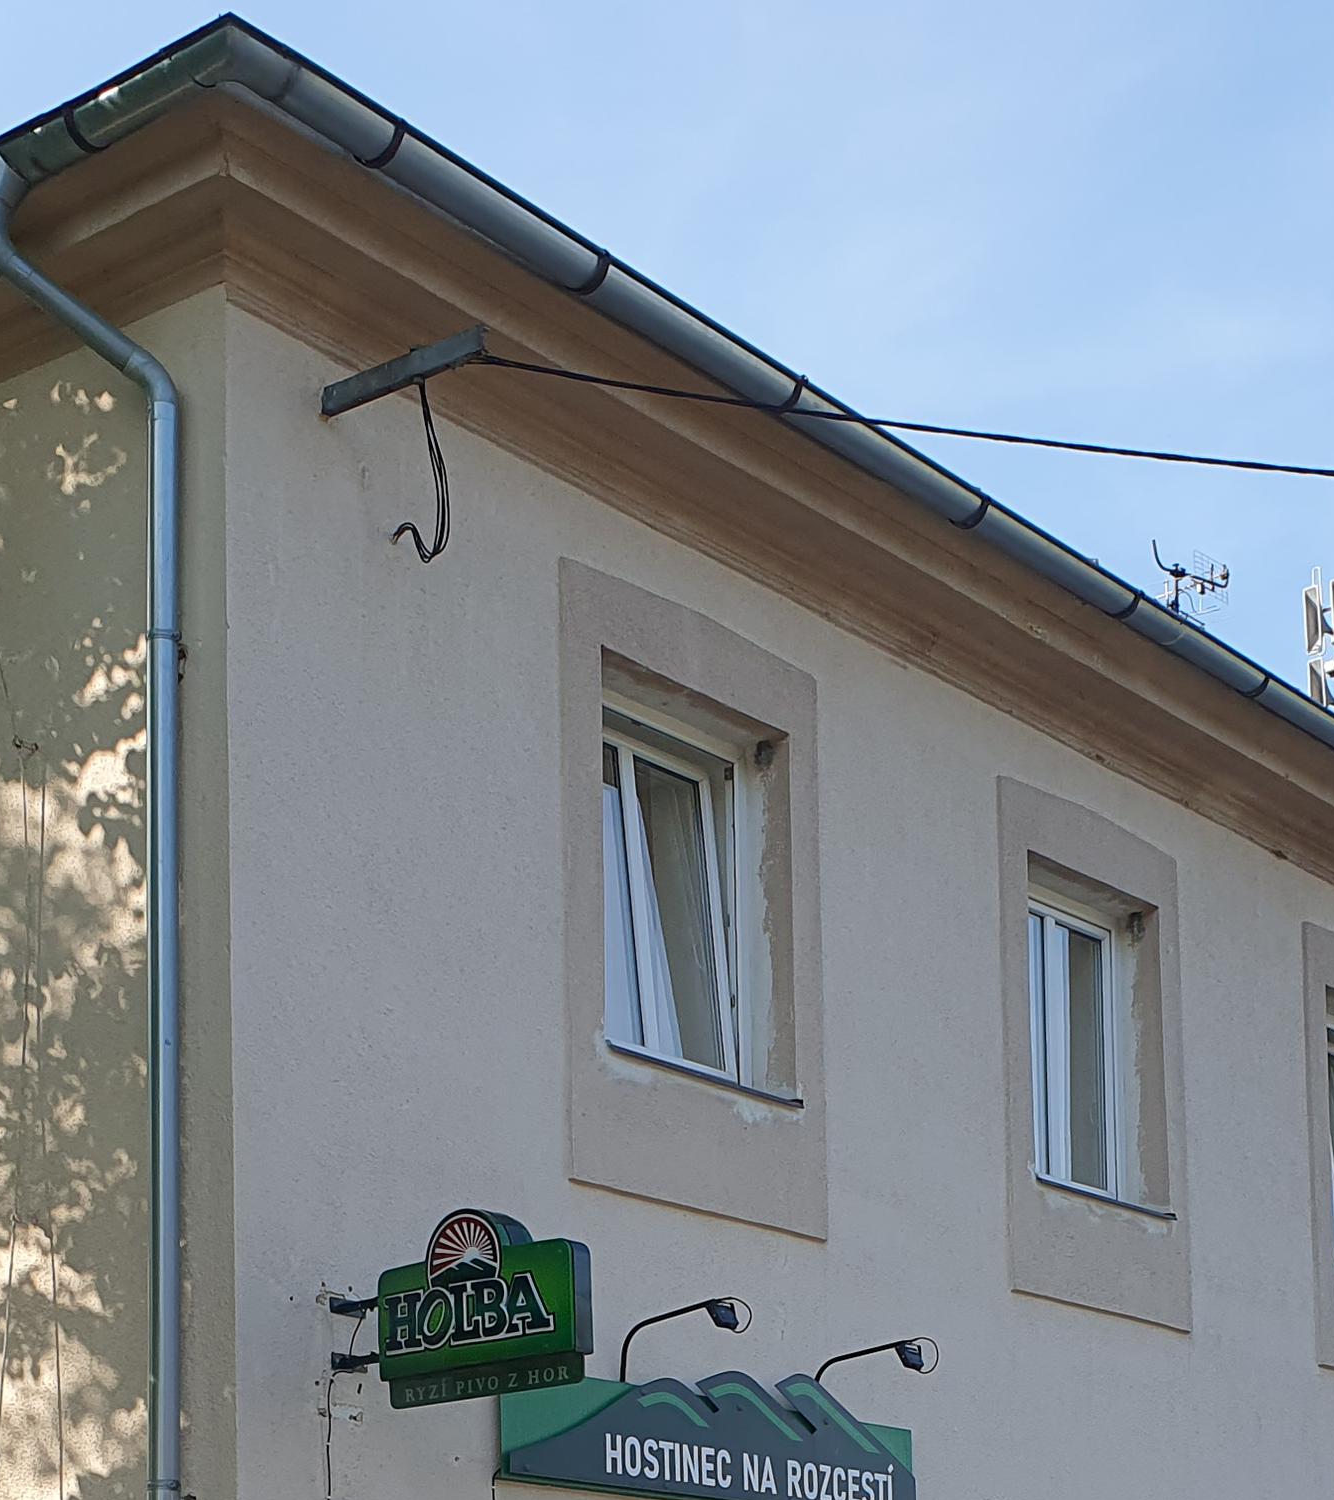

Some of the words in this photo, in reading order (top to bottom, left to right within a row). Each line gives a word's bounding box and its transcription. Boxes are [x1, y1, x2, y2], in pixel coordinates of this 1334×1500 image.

[384, 1271, 556, 1356] HOLBA
[404, 1377, 447, 1403] RYZÍ
[456, 1374, 499, 1395] PIVO
[507, 1372, 519, 1388] Z
[527, 1365, 570, 1386] HOR
[604, 1432, 733, 1490] HOSTINEC
[741, 1451, 779, 1496] NA
